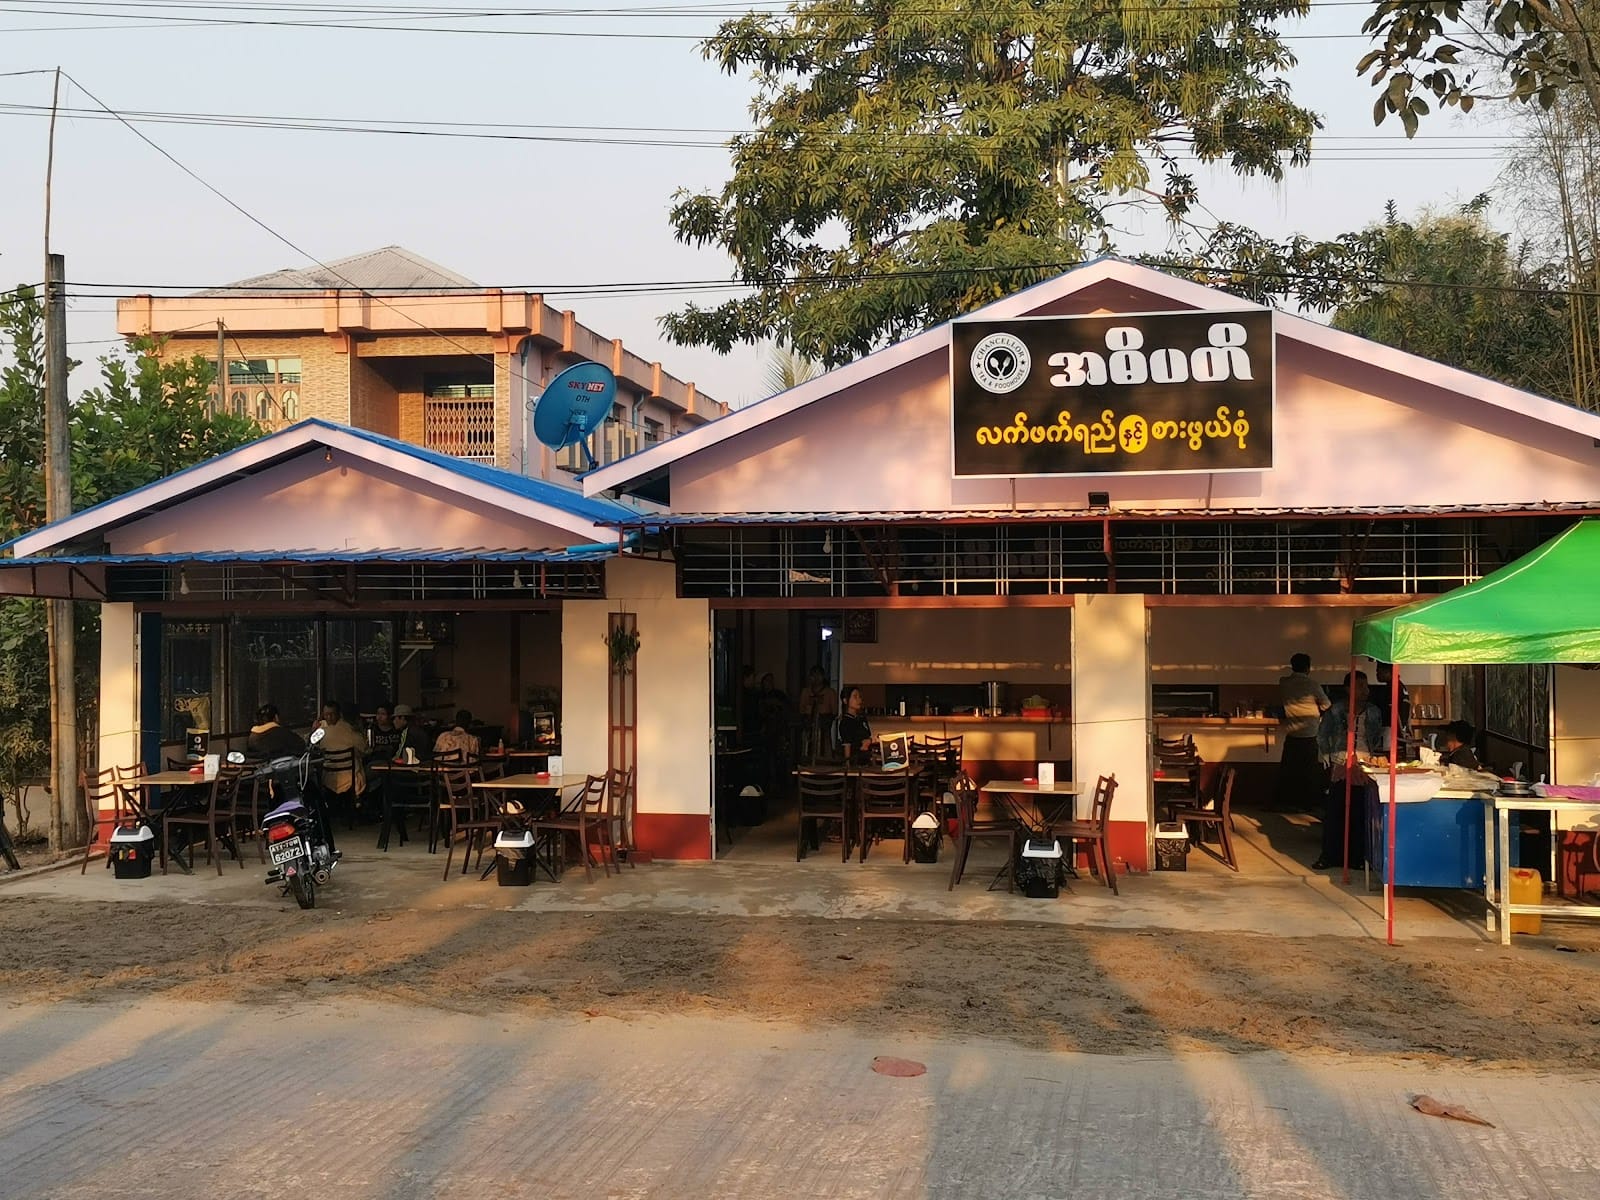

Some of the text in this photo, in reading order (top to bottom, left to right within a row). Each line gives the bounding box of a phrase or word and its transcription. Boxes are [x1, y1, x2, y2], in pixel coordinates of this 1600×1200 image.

[976, 337, 1025, 361] CHANCELLOR
[978, 371, 988, 383] TEA
[568, 381, 605, 392] SKYNET
[275, 847, 301, 862] 62072
